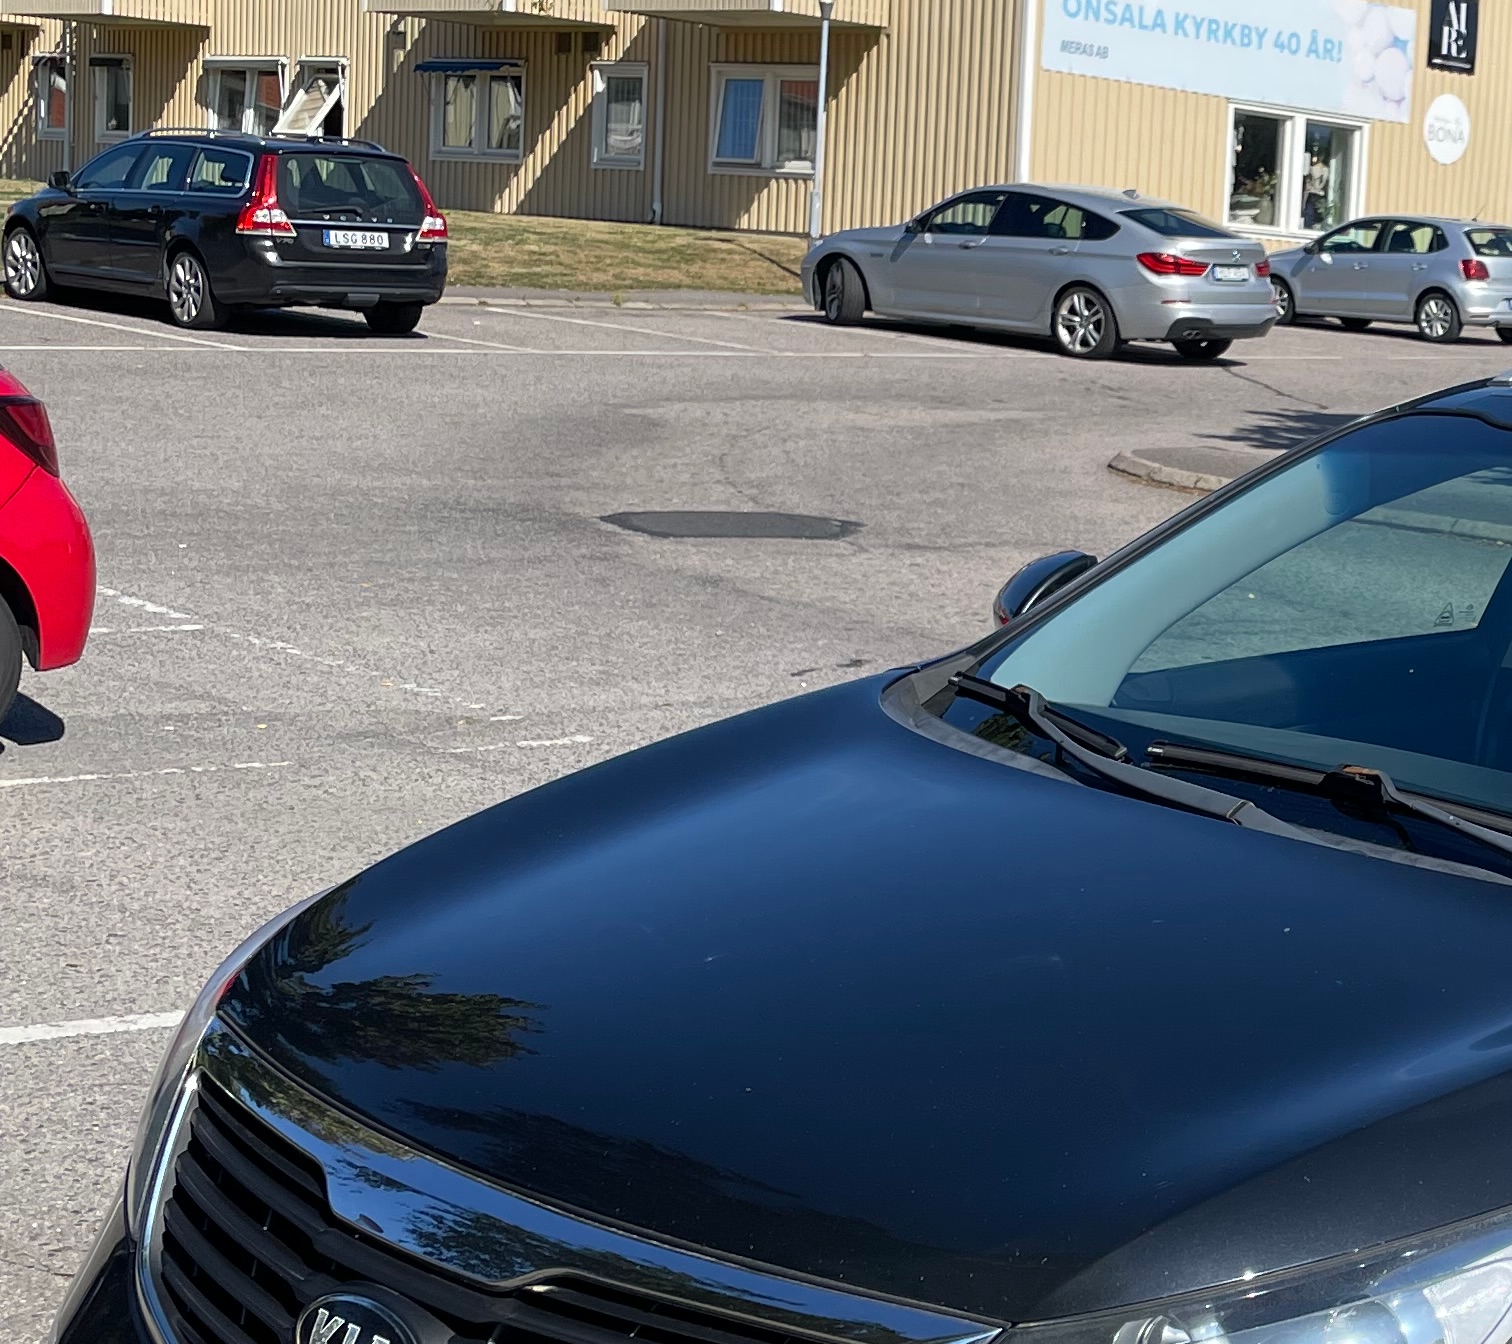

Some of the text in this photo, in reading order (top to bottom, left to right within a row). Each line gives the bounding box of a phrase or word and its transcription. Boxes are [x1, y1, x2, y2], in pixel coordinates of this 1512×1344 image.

[1173, 12, 1269, 51] KYRKBY
[1273, 30, 1301, 57] 40
[1305, 29, 1344, 63] ÅR!
[334, 232, 384, 245] LSG 880
